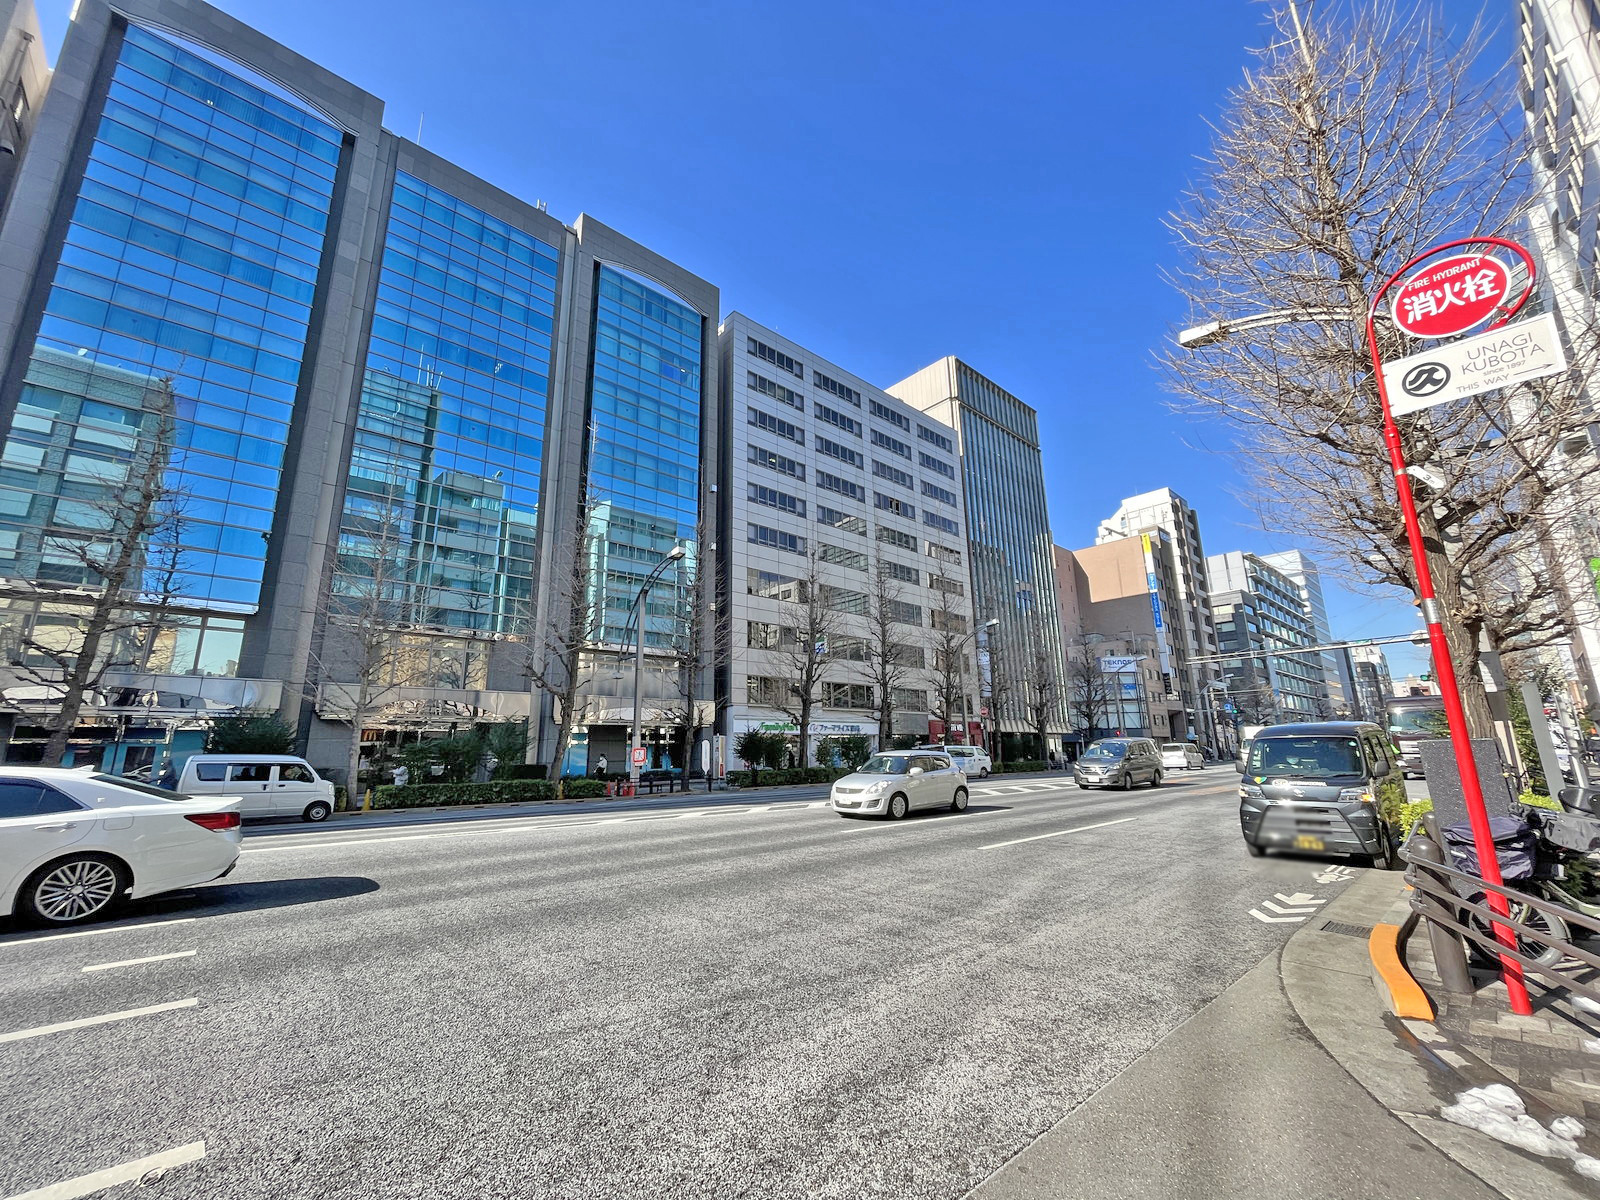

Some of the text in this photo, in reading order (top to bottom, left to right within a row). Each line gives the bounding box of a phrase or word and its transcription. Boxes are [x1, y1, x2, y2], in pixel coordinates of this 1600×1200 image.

[1408, 258, 1481, 291] FIRE HYDRANT
[1402, 268, 1500, 324] 消火栓
[1461, 343, 1545, 375] KUBOTA
[1466, 332, 1533, 360] UNAGI
[1456, 373, 1510, 393] THIS WAY
[1482, 360, 1526, 376] since 1897
